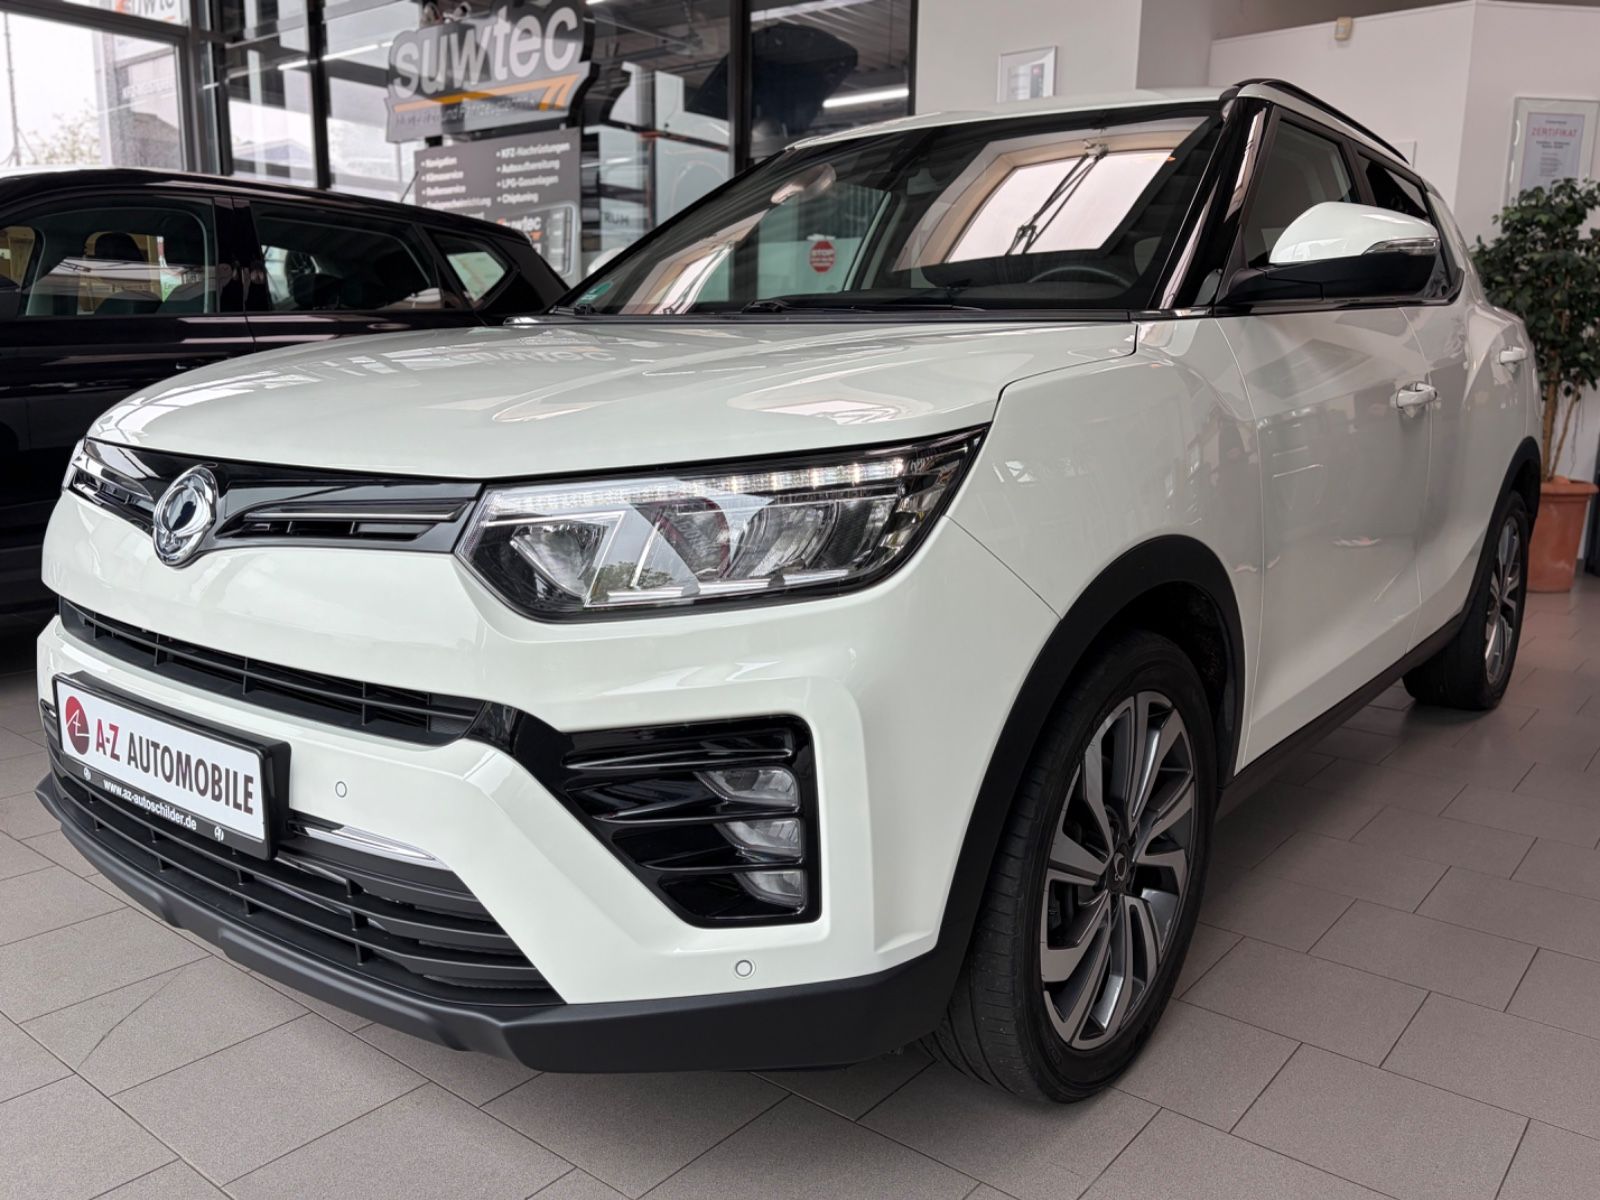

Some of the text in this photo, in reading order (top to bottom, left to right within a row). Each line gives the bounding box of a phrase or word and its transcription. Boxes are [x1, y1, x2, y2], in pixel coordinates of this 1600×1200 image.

[394, 7, 578, 98] suwtec
[1532, 127, 1577, 138] ZERTIFIKAT
[96, 718, 254, 815] A-Z AUTOMOBILE
[103, 779, 197, 831] www.az-autoschilder.de
